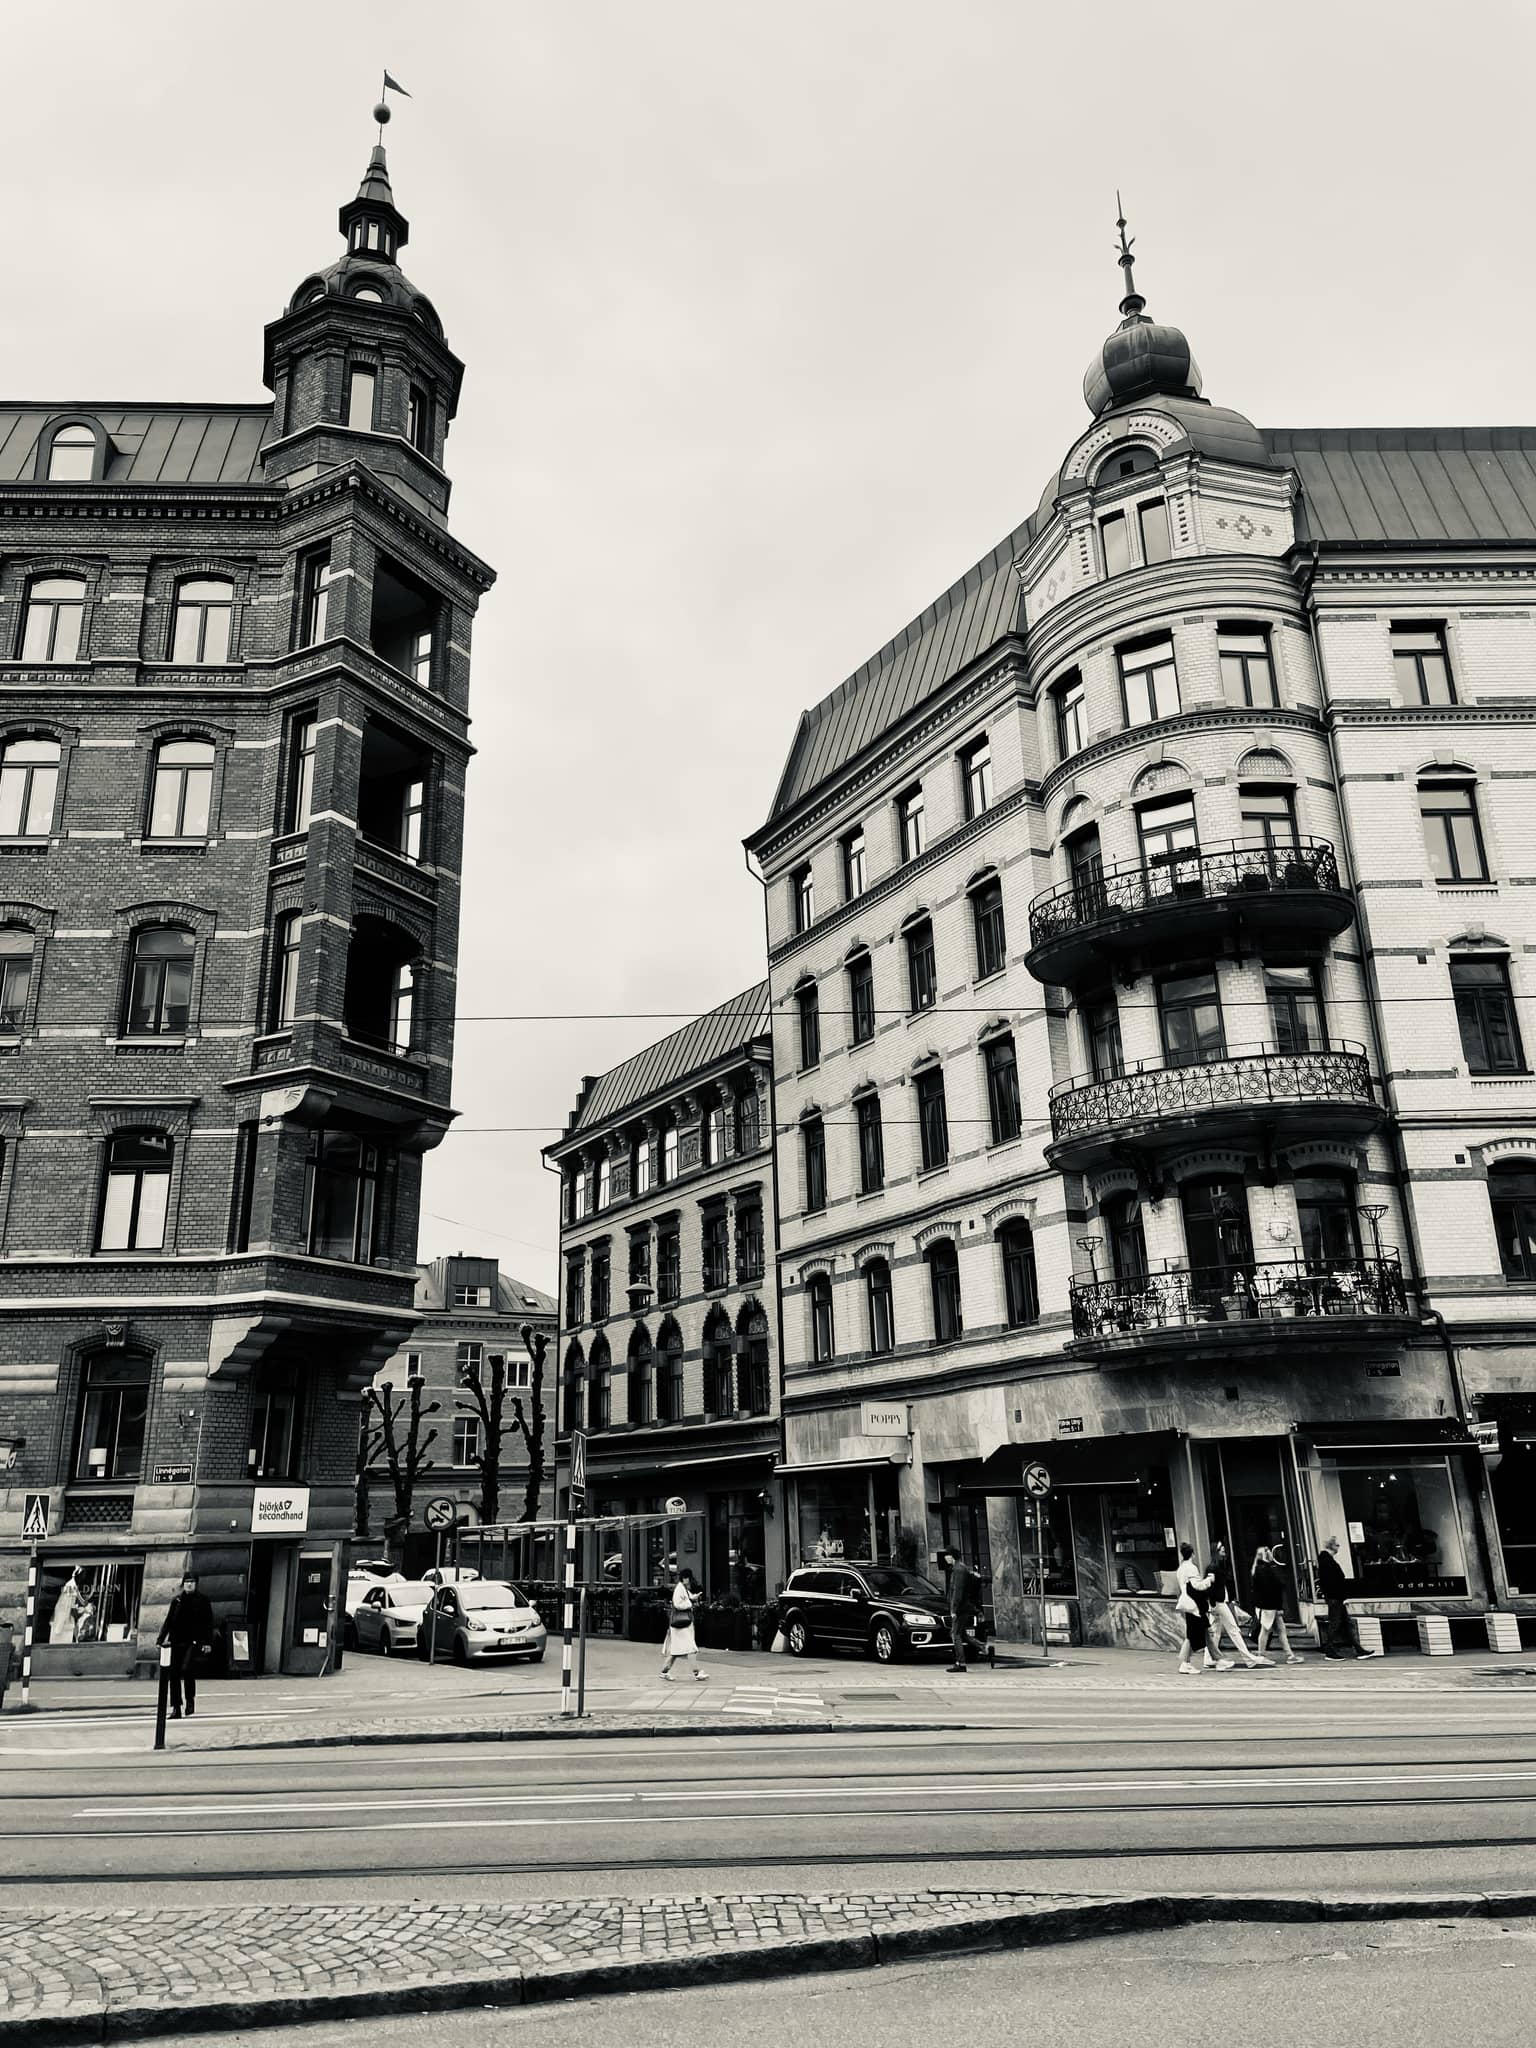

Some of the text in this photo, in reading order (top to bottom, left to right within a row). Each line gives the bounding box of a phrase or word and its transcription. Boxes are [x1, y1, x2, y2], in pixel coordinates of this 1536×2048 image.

[870, 1414, 901, 1424] POPPY
[155, 1467, 191, 1476] Linnégatan
[258, 1510, 304, 1520] secondhand
